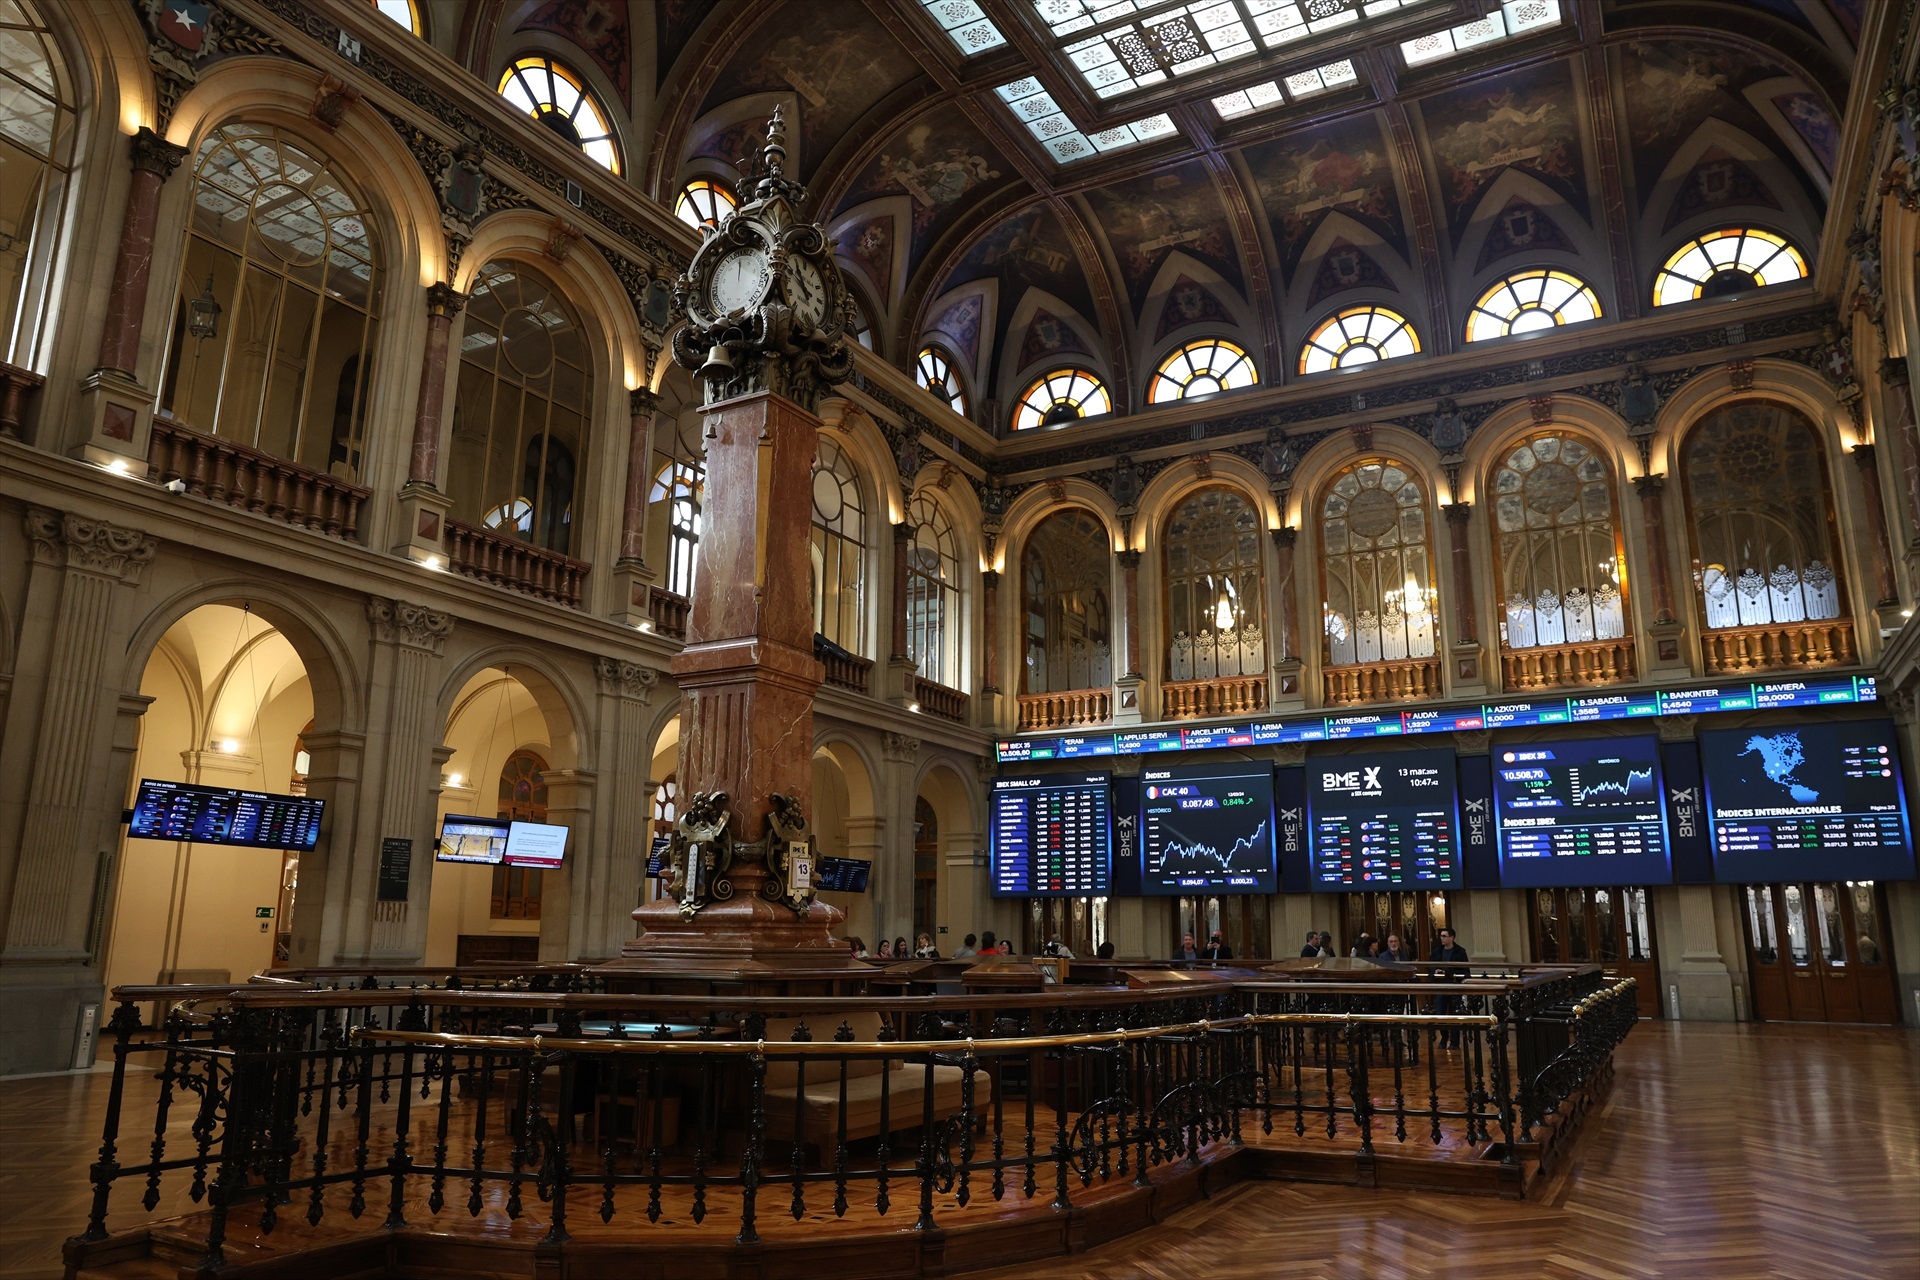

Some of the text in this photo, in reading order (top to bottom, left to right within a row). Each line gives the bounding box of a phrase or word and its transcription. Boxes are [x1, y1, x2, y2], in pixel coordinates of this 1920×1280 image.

[1765, 683, 1806, 692] BAVIERA
[1670, 690, 1718, 700] BANKINTER
[1757, 694, 1794, 702] 29,0000
[1580, 696, 1629, 706] B.SABADELL
[1662, 701, 1692, 709] 6,4540
[1494, 704, 1530, 713] AZKOYEN
[1335, 715, 1381, 725] ATRESMEDIA
[1191, 727, 1236, 736] ARCEL.MITTAL
[1145, 772, 1170, 780] ÍNDICES
[1504, 770, 1543, 779] 10.508,70
[1323, 772, 1360, 788] BME
[1182, 798, 1244, 808] 8.087,48 0,84%
[1717, 806, 1842, 817] ÍNDICES INTERNACIONALES
[1504, 818, 1535, 826] ÍNDICES
[1677, 806, 1693, 837] BME
[1470, 815, 1483, 844] BME
[1284, 824, 1296, 852] BME
[1121, 830, 1130, 857] BME
[798, 864, 808, 875] 13
